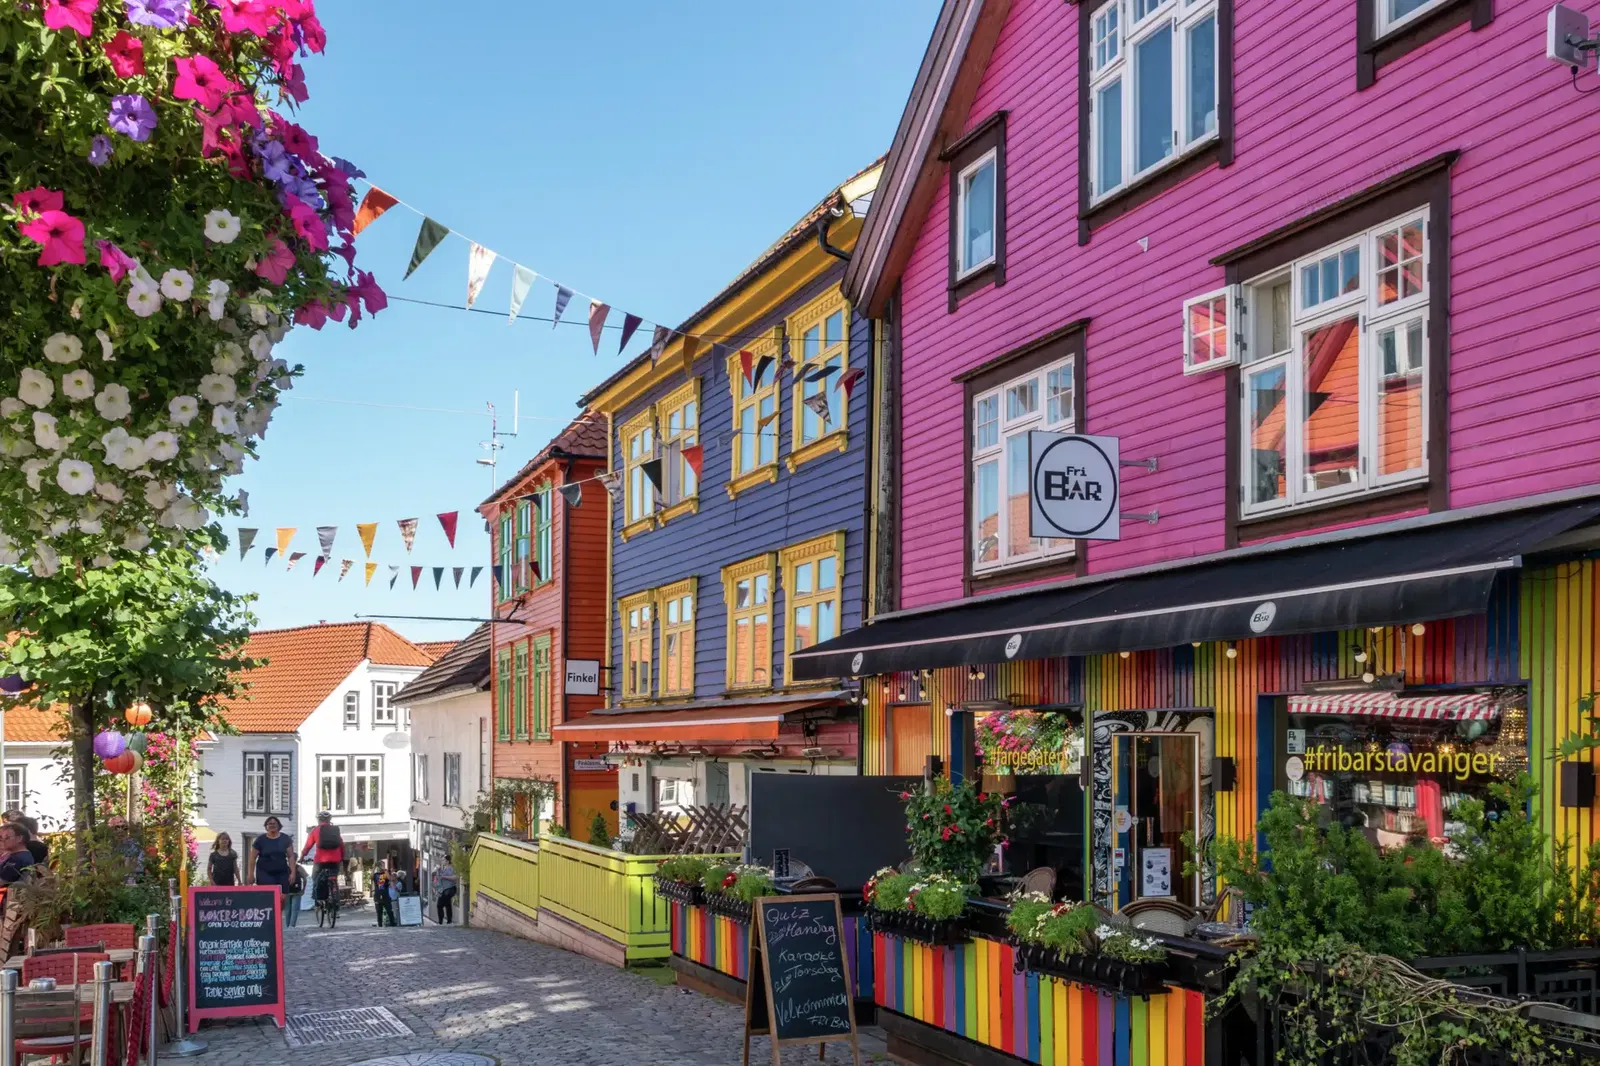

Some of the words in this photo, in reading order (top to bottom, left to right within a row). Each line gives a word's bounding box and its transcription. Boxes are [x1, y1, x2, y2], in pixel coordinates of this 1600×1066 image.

[1066, 466, 1087, 477] Fri
[1044, 470, 1102, 501] BAR
[1253, 613, 1270, 623] BAR
[567, 672, 597, 683] Finkel
[1304, 744, 1500, 781] #fribarstavanger
[766, 906, 810, 927] Quiz
[778, 947, 837, 963] Karaoke
[783, 961, 843, 983] Torsdag
[204, 987, 222, 997] Table
[223, 985, 246, 998] service
[247, 984, 262, 997] only
